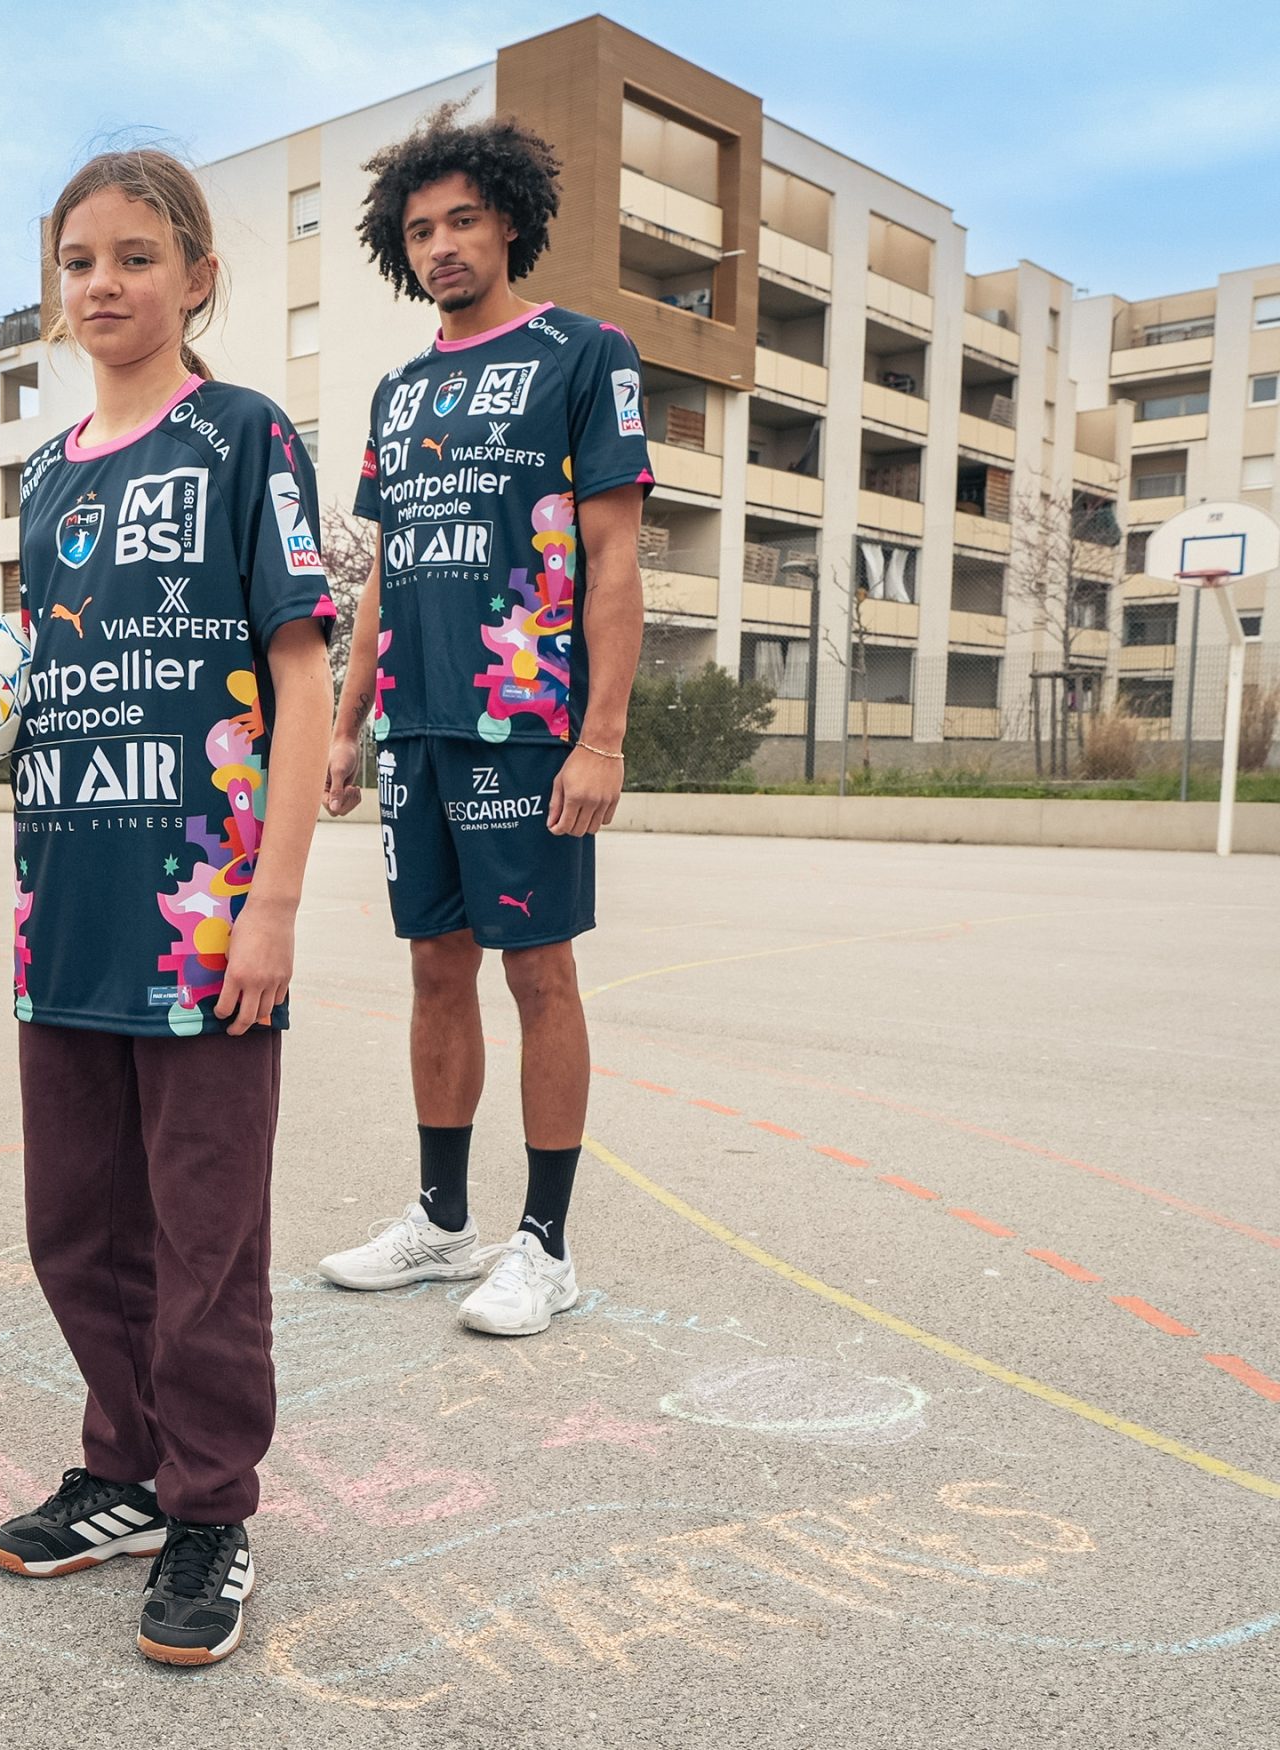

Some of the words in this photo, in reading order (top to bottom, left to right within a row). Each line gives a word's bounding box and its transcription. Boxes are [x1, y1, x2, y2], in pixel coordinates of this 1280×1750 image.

[483, 370, 517, 393] M
[382, 378, 429, 438] 93
[467, 391, 513, 416] BS
[451, 446, 546, 468] VIAEXPERTS
[128, 481, 175, 523] M
[183, 482, 195, 510] 1897
[66, 512, 99, 526] MHB
[180, 512, 193, 549] since
[115, 521, 182, 566] BS
[419, 524, 488, 563] AIR
[426, 571, 489, 581] FITNESS
[100, 616, 250, 642] VIAEXPERTS
[15, 748, 61, 807] ON
[75, 741, 178, 804] AIR
[92, 817, 184, 830] FITNESS
[460, 823, 489, 831] GRAND
[490, 820, 519, 829] MASSIF
[380, 823, 398, 882] 3
